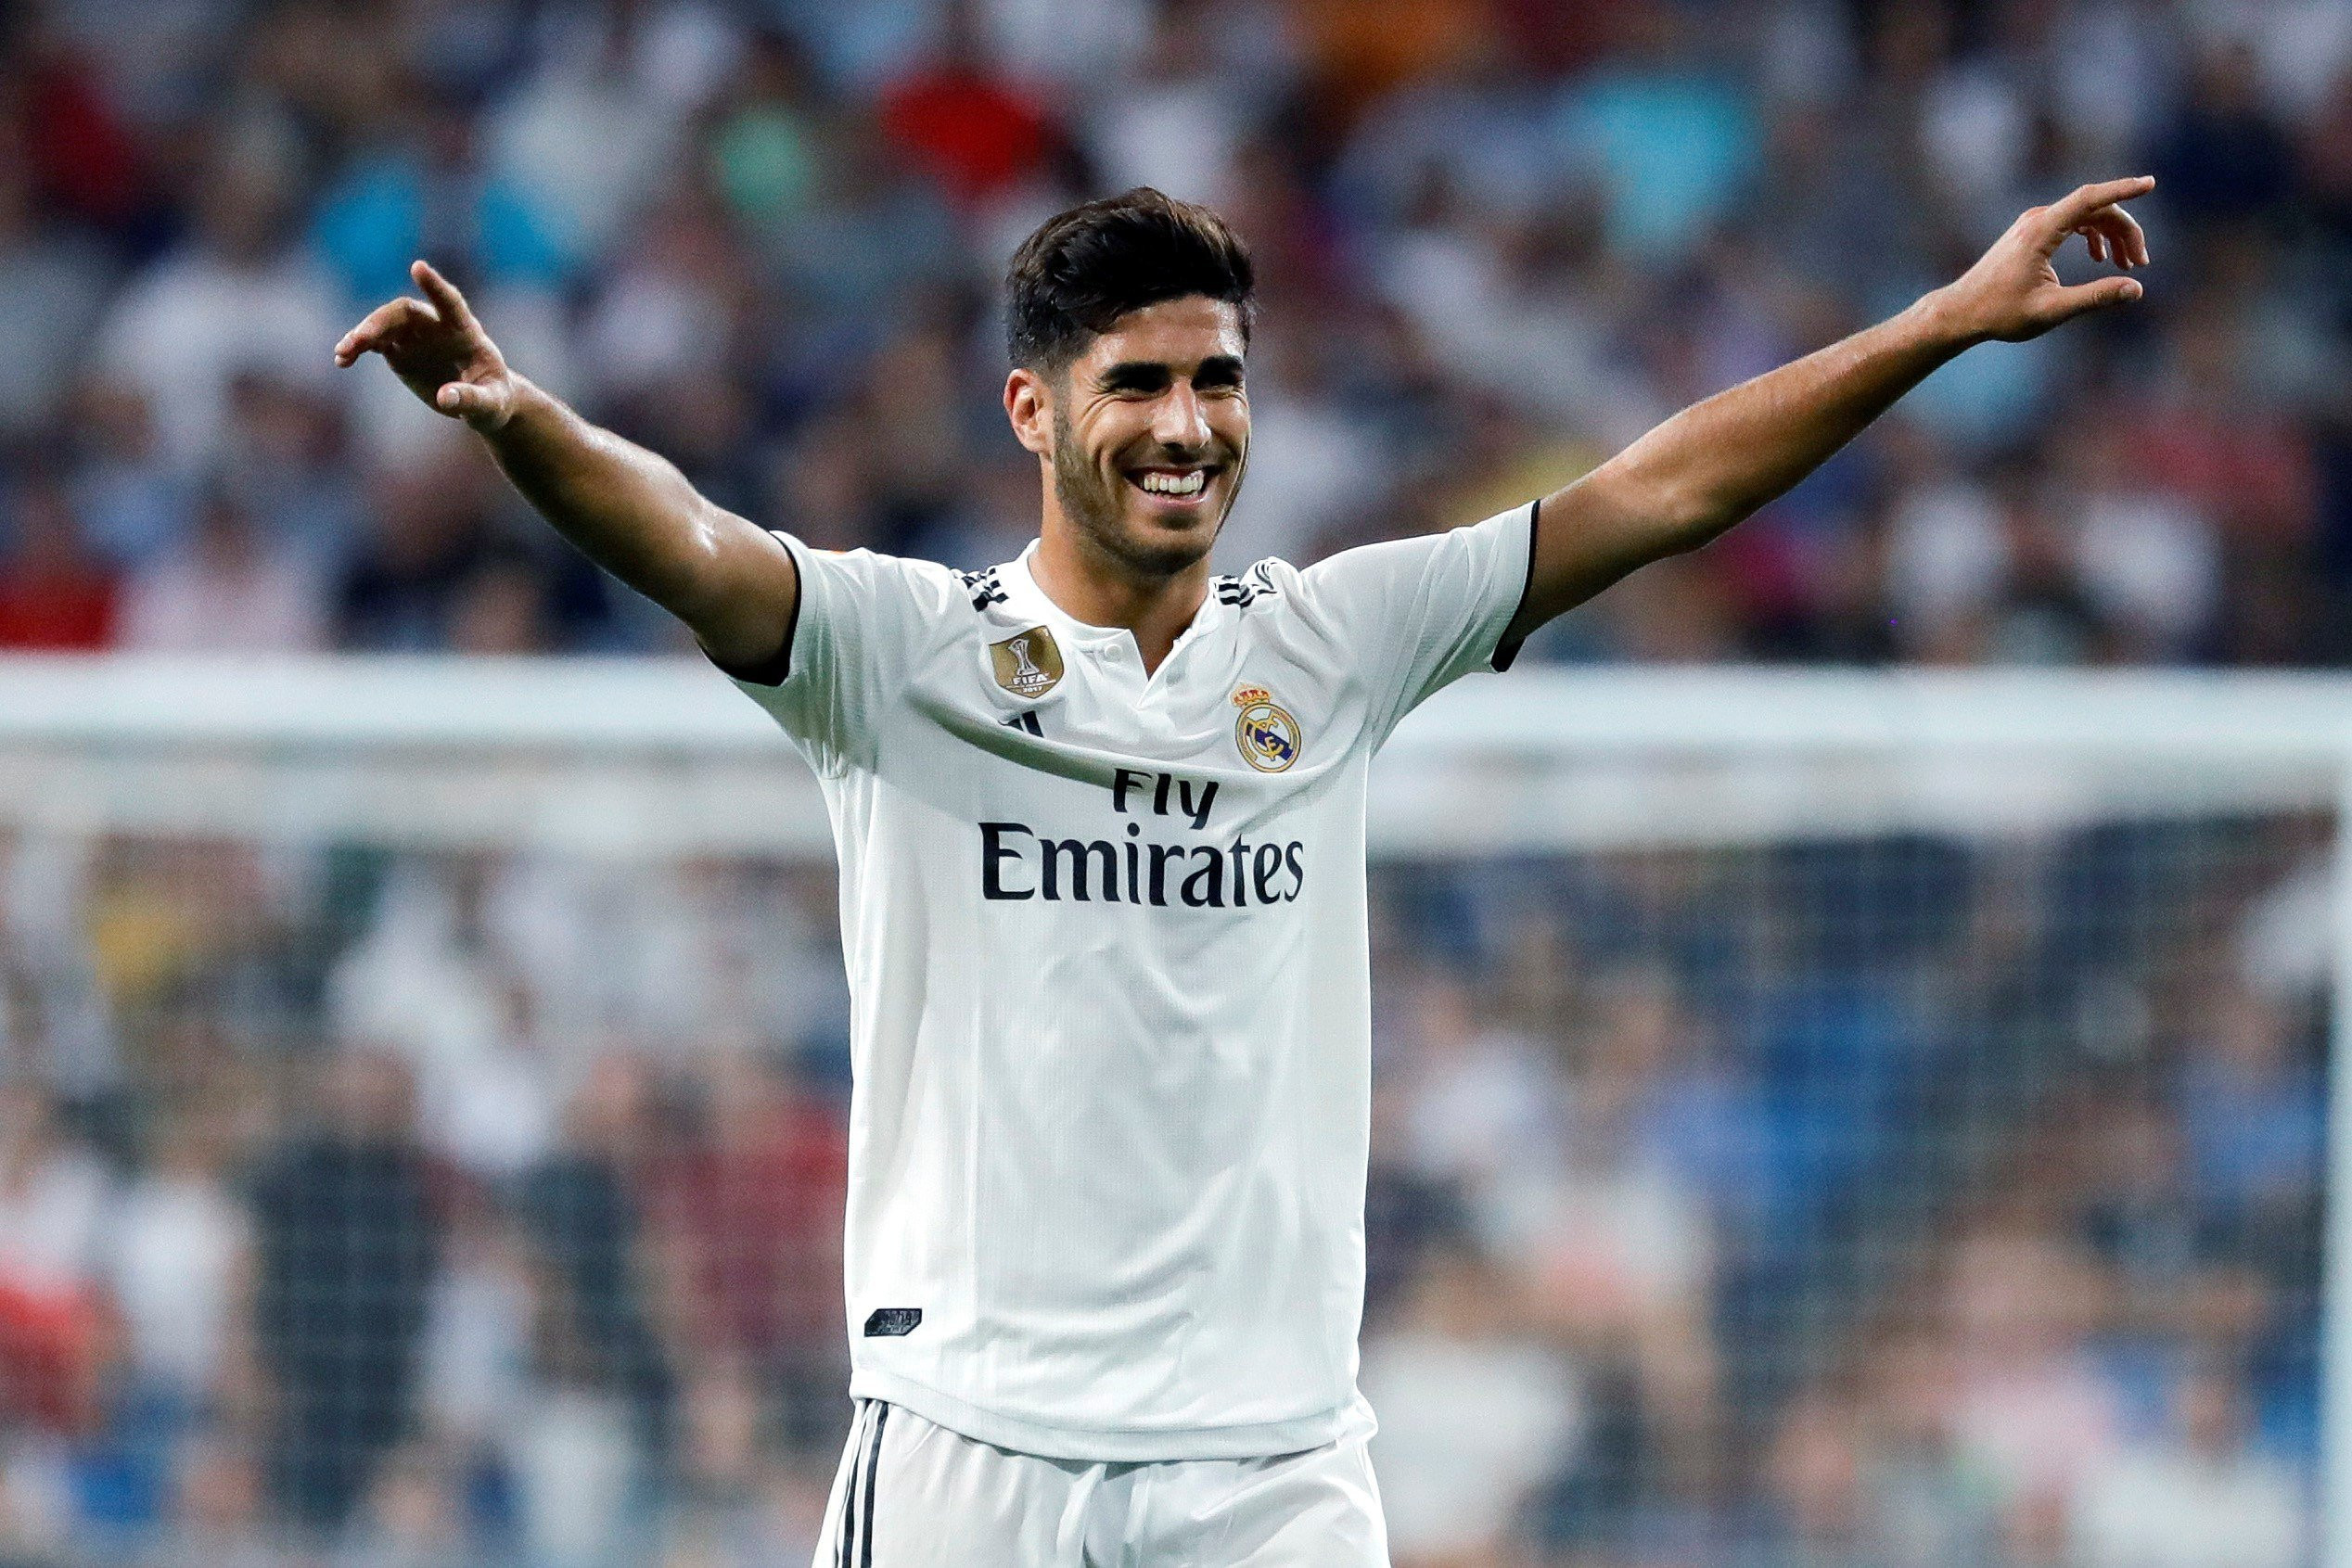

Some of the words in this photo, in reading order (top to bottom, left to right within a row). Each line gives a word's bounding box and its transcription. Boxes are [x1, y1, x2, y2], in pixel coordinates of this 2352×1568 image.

[1012, 673, 1047, 684] FIFA
[1114, 768, 1220, 830] Fly
[978, 822, 1303, 908] Emirates
